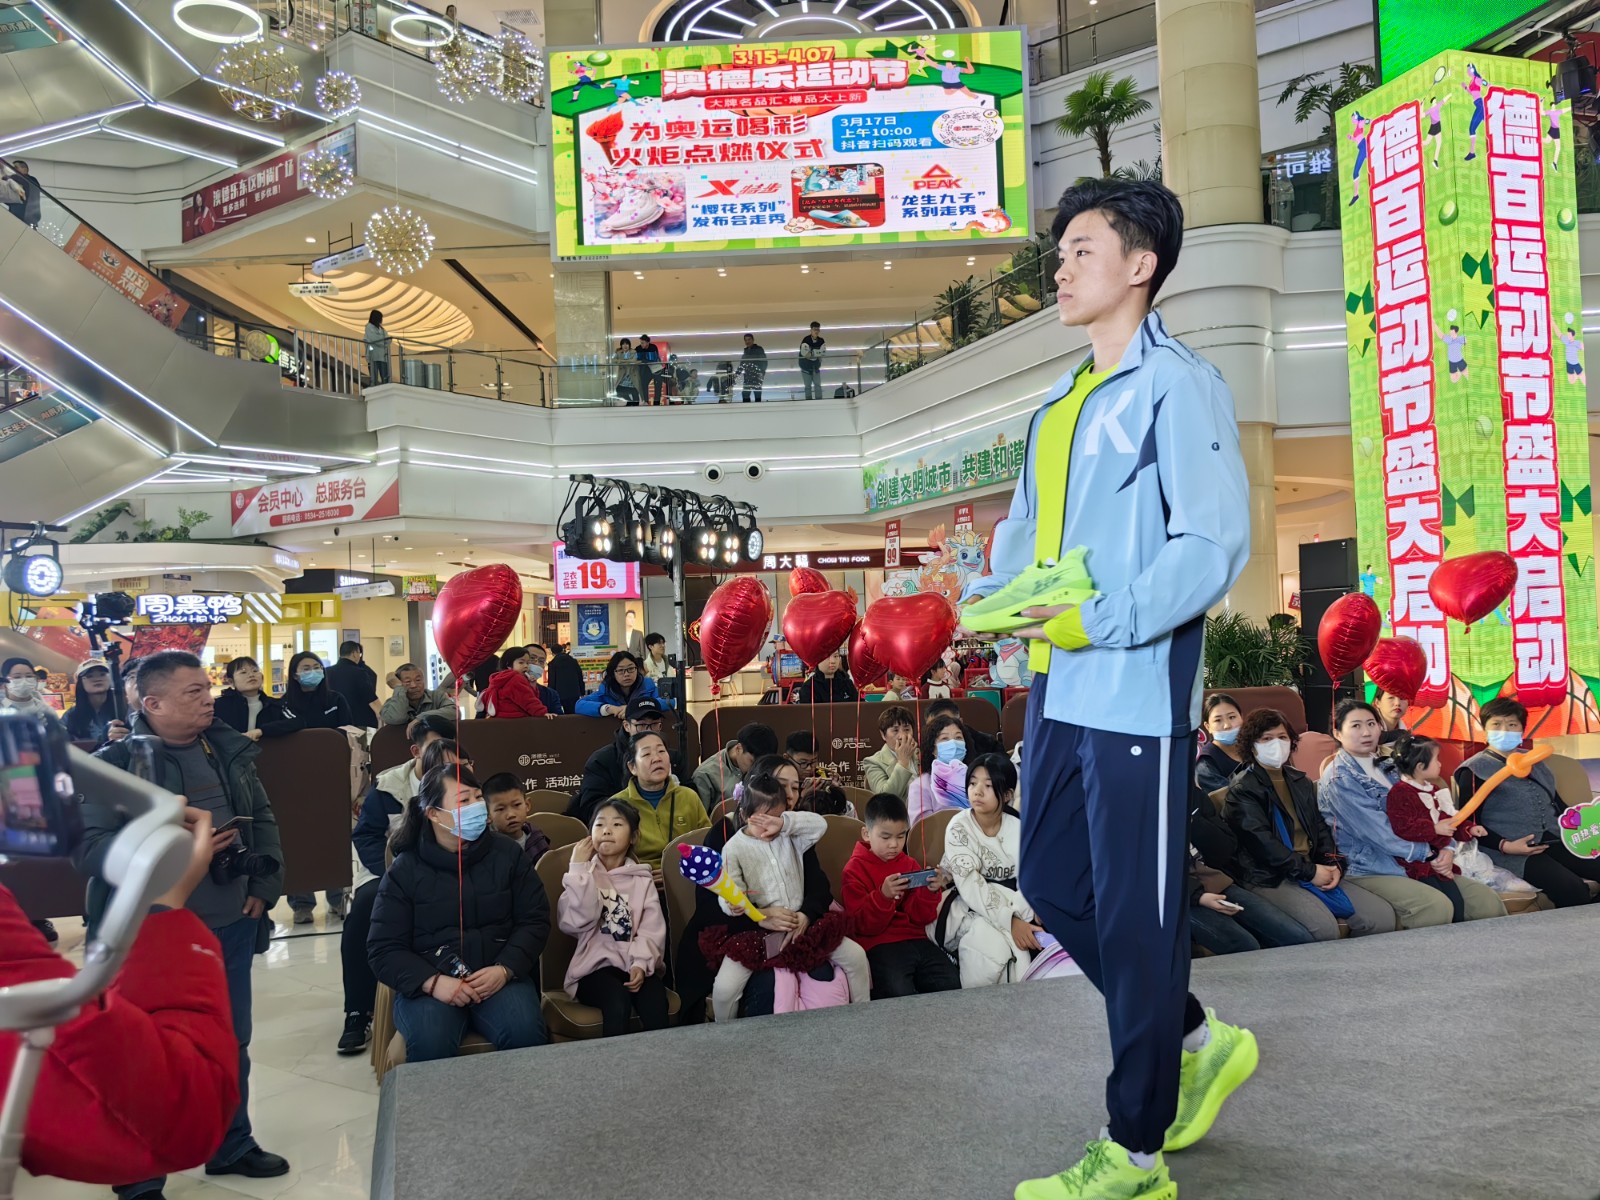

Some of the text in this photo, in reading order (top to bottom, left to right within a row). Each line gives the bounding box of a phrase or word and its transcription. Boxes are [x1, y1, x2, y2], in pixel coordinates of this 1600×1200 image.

[734, 48, 833, 64] 3.15-4.07
[663, 60, 908, 95] 澳德乐运动节
[710, 94, 862, 108] 大牌名品汇·爆品大上新
[630, 114, 807, 142] 为奥运喝彩
[840, 116, 897, 127] 3月17日
[840, 127, 912, 138] 上午10:00
[841, 137, 932, 150] 抖音扫码观看
[612, 138, 824, 167] 火炬点燃仪式
[913, 179, 962, 190] PEAK
[902, 205, 976, 218] 系列走秀
[692, 213, 786, 228] 发布会走秀
[1486, 90, 1566, 686] 德百运动节盛大启动
[877, 440, 1025, 505] 创建文明城市 共建和谐
[257, 477, 367, 513] 会员中心 总服务台
[763, 554, 808, 569] 周大福
[887, 548, 897, 564] 99
[563, 571, 577, 580] 卫衣
[563, 581, 577, 589] 低至
[136, 594, 243, 616] 周黑鸭
[152, 614, 188, 623] ZHOU
[545, 774, 584, 788] 活动洽
